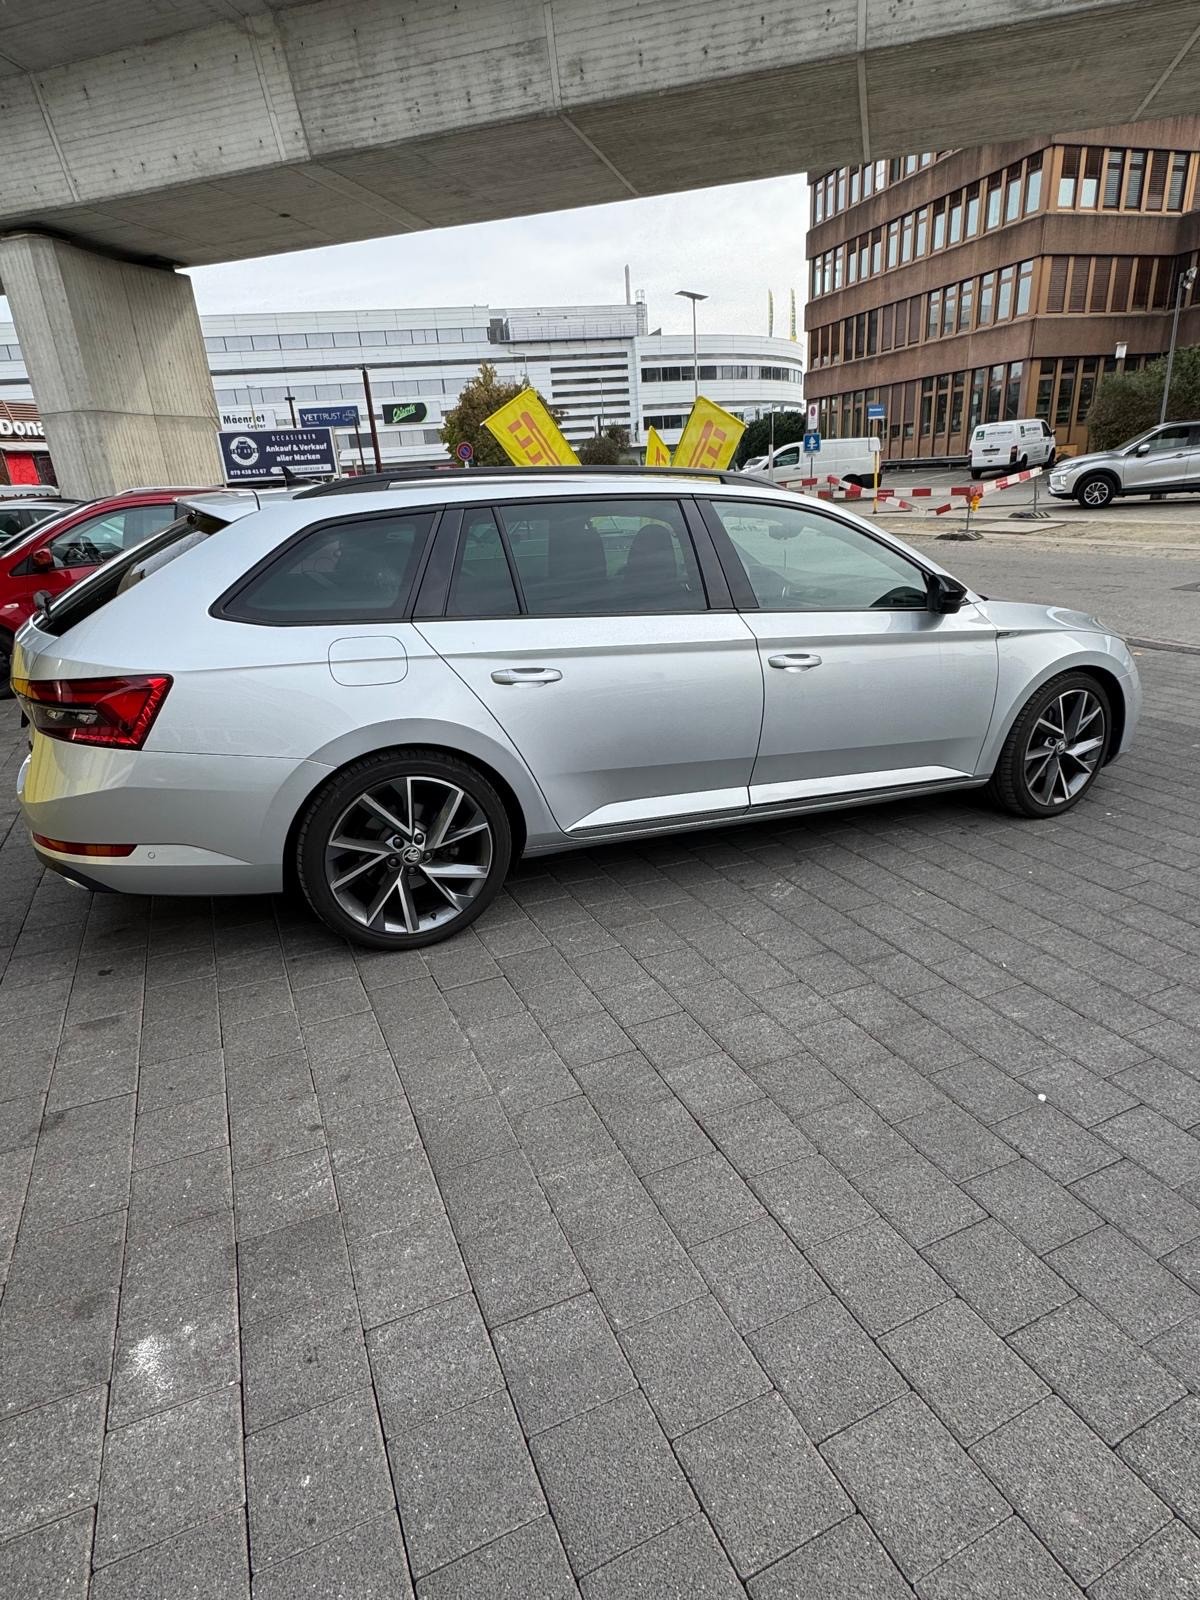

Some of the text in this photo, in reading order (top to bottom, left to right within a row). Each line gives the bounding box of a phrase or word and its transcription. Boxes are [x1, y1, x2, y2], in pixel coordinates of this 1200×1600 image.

[222, 413, 265, 424] Mäenret
[271, 433, 316, 442] OCCASIONEN
[265, 444, 292, 453] Ankauf
[298, 442, 327, 451] Verkauf
[276, 453, 321, 462] aller Marken
